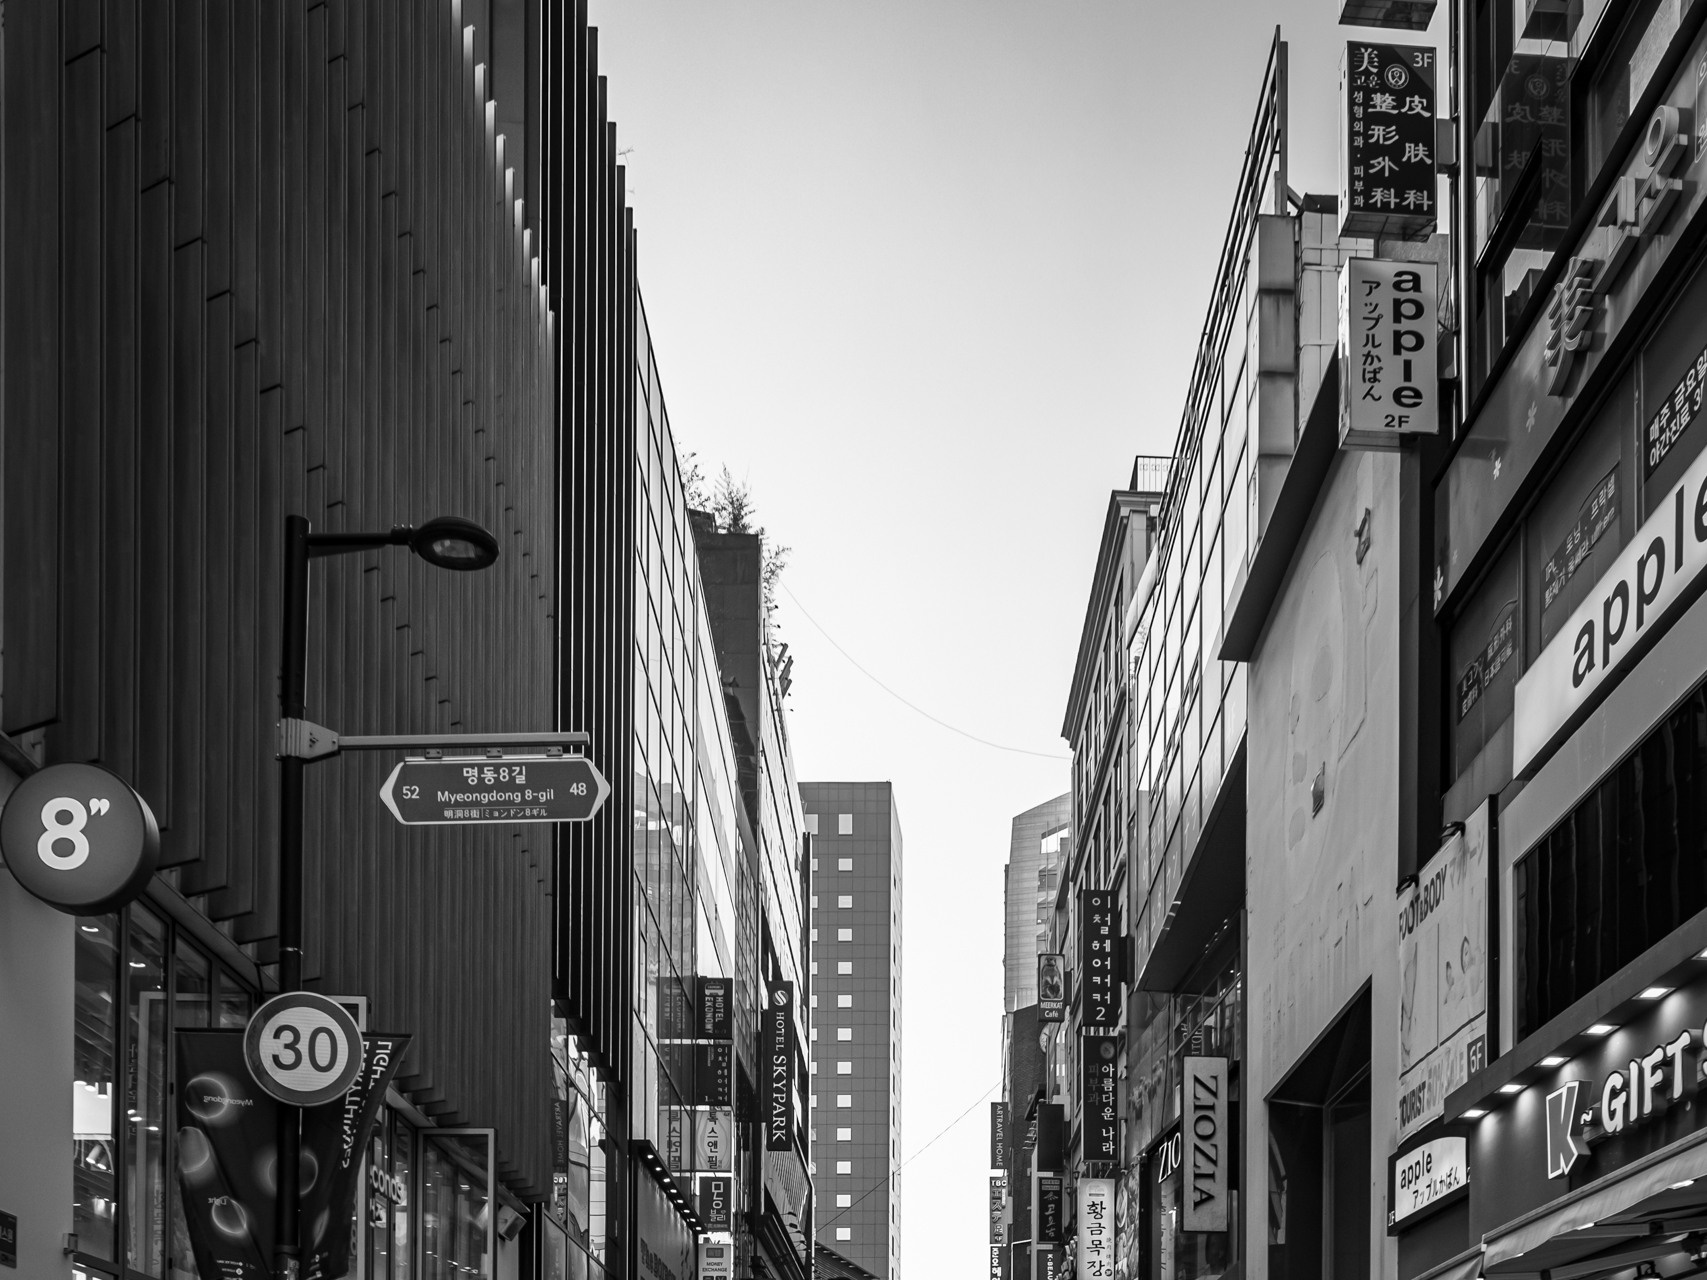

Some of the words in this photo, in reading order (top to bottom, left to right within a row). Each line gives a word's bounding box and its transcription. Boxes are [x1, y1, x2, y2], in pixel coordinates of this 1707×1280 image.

[1354, 46, 1379, 73] 美
[1413, 52, 1433, 68] 3F
[1352, 73, 1381, 89] 고운
[1368, 91, 1400, 209] 整形外科
[1361, 279, 1382, 402] アップルかばん
[1392, 269, 1425, 409] apple
[1649, 401, 1671, 442] 매주
[1674, 349, 1707, 412] 금요일
[1384, 413, 1410, 428] 2F
[1649, 400, 1691, 467] 야간진료
[1591, 473, 1615, 521] 프락셀
[402, 786, 420, 800] 52
[462, 766, 527, 785] 명동8길
[569, 782, 587, 797] 48
[437, 789, 521, 805] Myeongdong
[525, 788, 554, 804] 8-gil
[1091, 895, 1112, 1005] 이철헤어커커
[704, 996, 714, 1035] EKONOMY
[715, 996, 724, 1022] HOTEL
[1040, 1001, 1063, 1010] MEERKAT
[1096, 1007, 1106, 1021] 2
[271, 1025, 338, 1073] 30
[776, 1012, 785, 1051] HOTEL
[1469, 1041, 1484, 1073] 6F
[773, 1055, 786, 1143] SKYPARK
[1088, 1063, 1100, 1106] 피부과
[1101, 1063, 1115, 1121] 아름다운
[996, 1105, 1004, 1138] ARTRAVEL
[1398, 1078, 1427, 1131] TOURIST
[1102, 1126, 1115, 1155] 나라
[1193, 1074, 1219, 1210] ZIOZIA
[991, 1179, 1007, 1187] TBC
[1400, 1149, 1433, 1190] apple
[1412, 1165, 1460, 1209] アップルかばん
[1086, 1201, 1107, 1277] 황금목장
